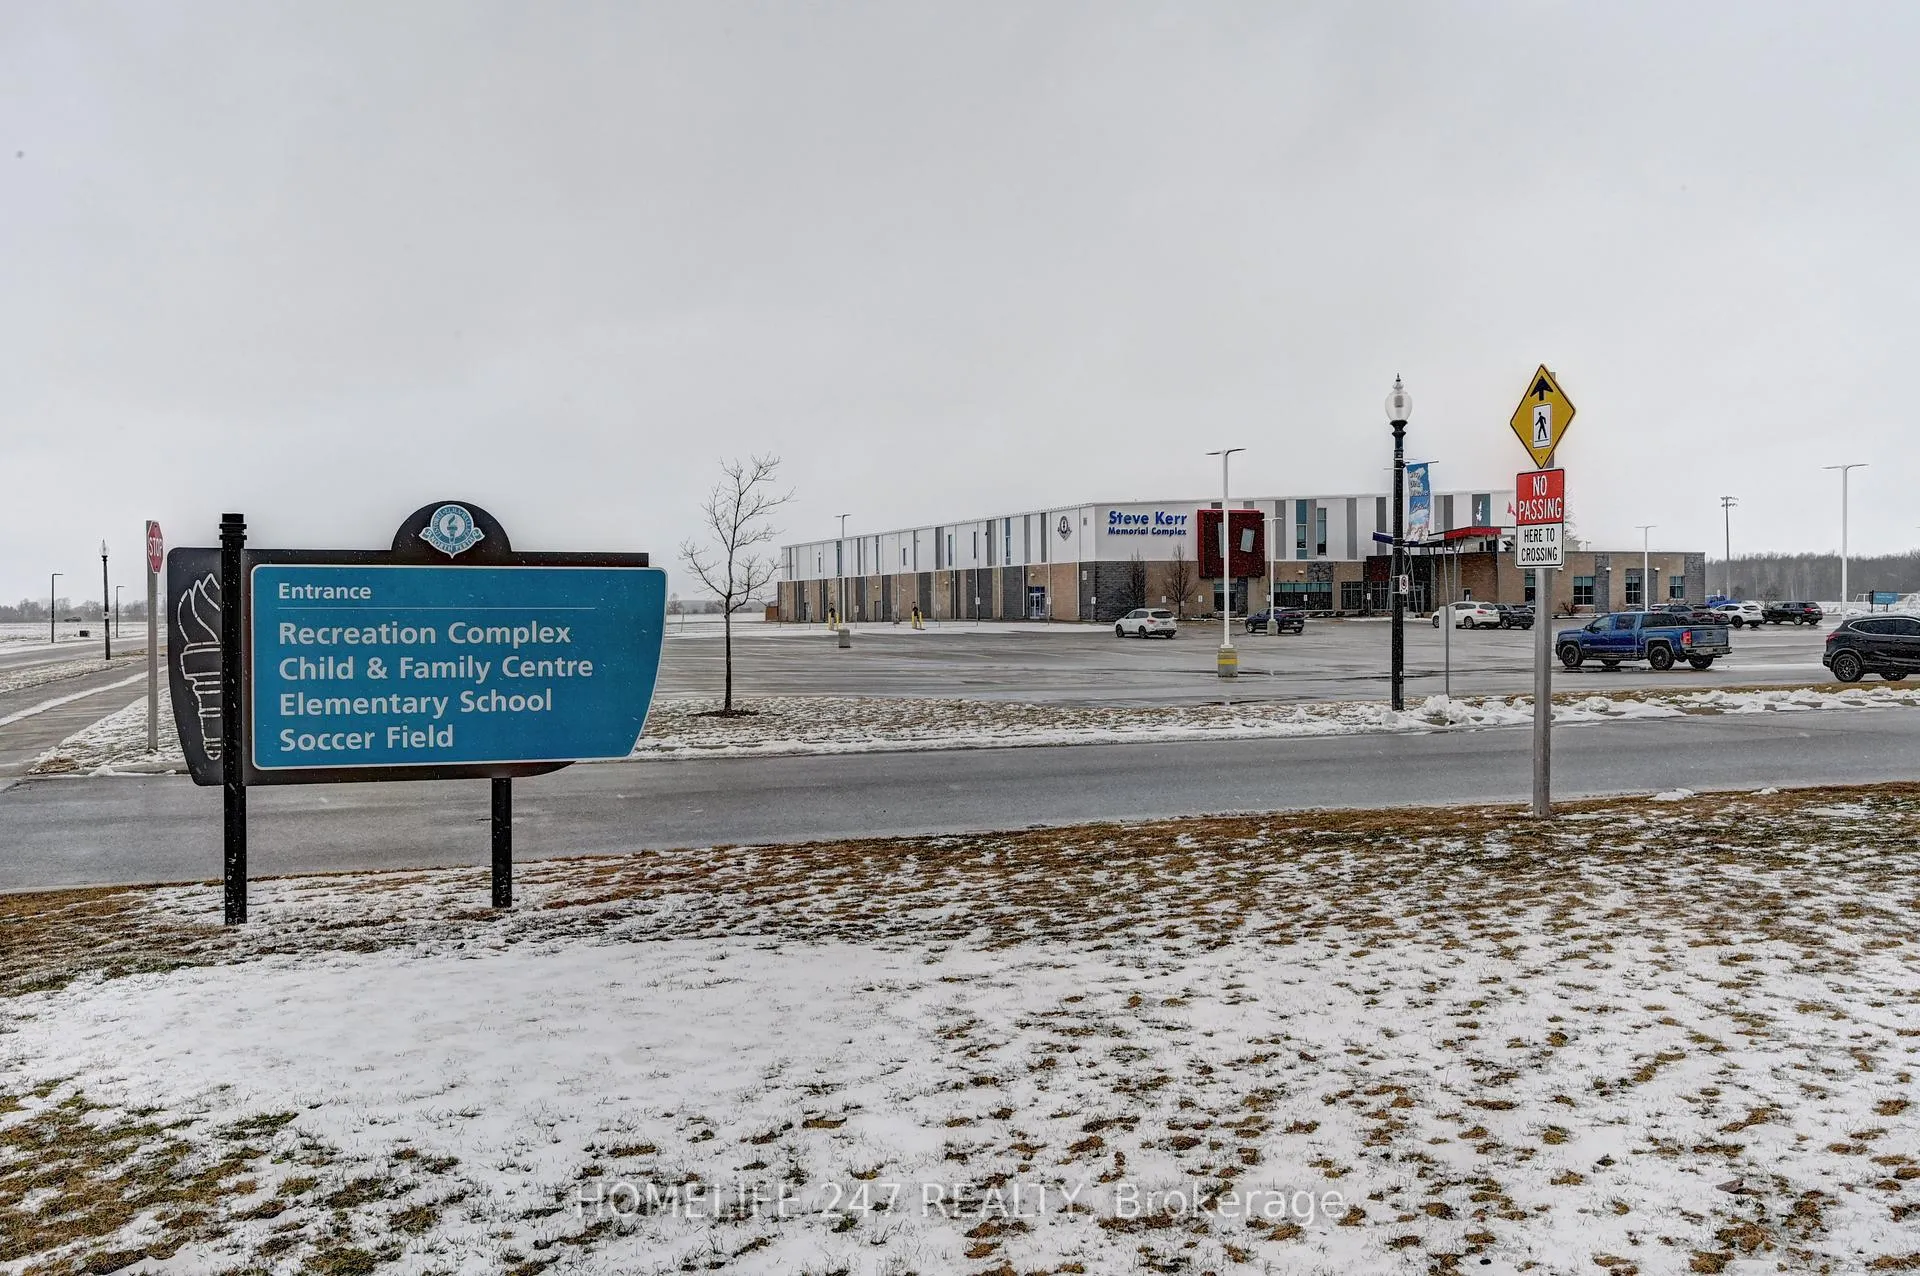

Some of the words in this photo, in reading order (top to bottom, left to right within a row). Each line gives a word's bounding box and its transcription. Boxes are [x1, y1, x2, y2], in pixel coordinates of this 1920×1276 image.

[1533, 475, 1547, 496] NO
[1108, 510, 1149, 525] Steve
[1155, 511, 1188, 525] Kerr
[1519, 498, 1561, 520] PASSING
[1108, 527, 1149, 536] Memorial
[1151, 527, 1187, 537] Complex
[1525, 529, 1542, 542] HERE
[1546, 528, 1554, 542] TO
[148, 536, 163, 557] STOP
[1522, 547, 1557, 561] CROSSING
[279, 583, 371, 599] Entrance
[280, 622, 435, 644] Recreation
[449, 621, 570, 648] Complex
[280, 656, 353, 680] Child
[367, 658, 387, 679] &
[401, 656, 490, 684] Family
[503, 656, 592, 677] Centre
[281, 692, 448, 719] Elementary
[461, 689, 551, 712] School
[280, 729, 375, 751] Soccer
[388, 725, 452, 748] Field
